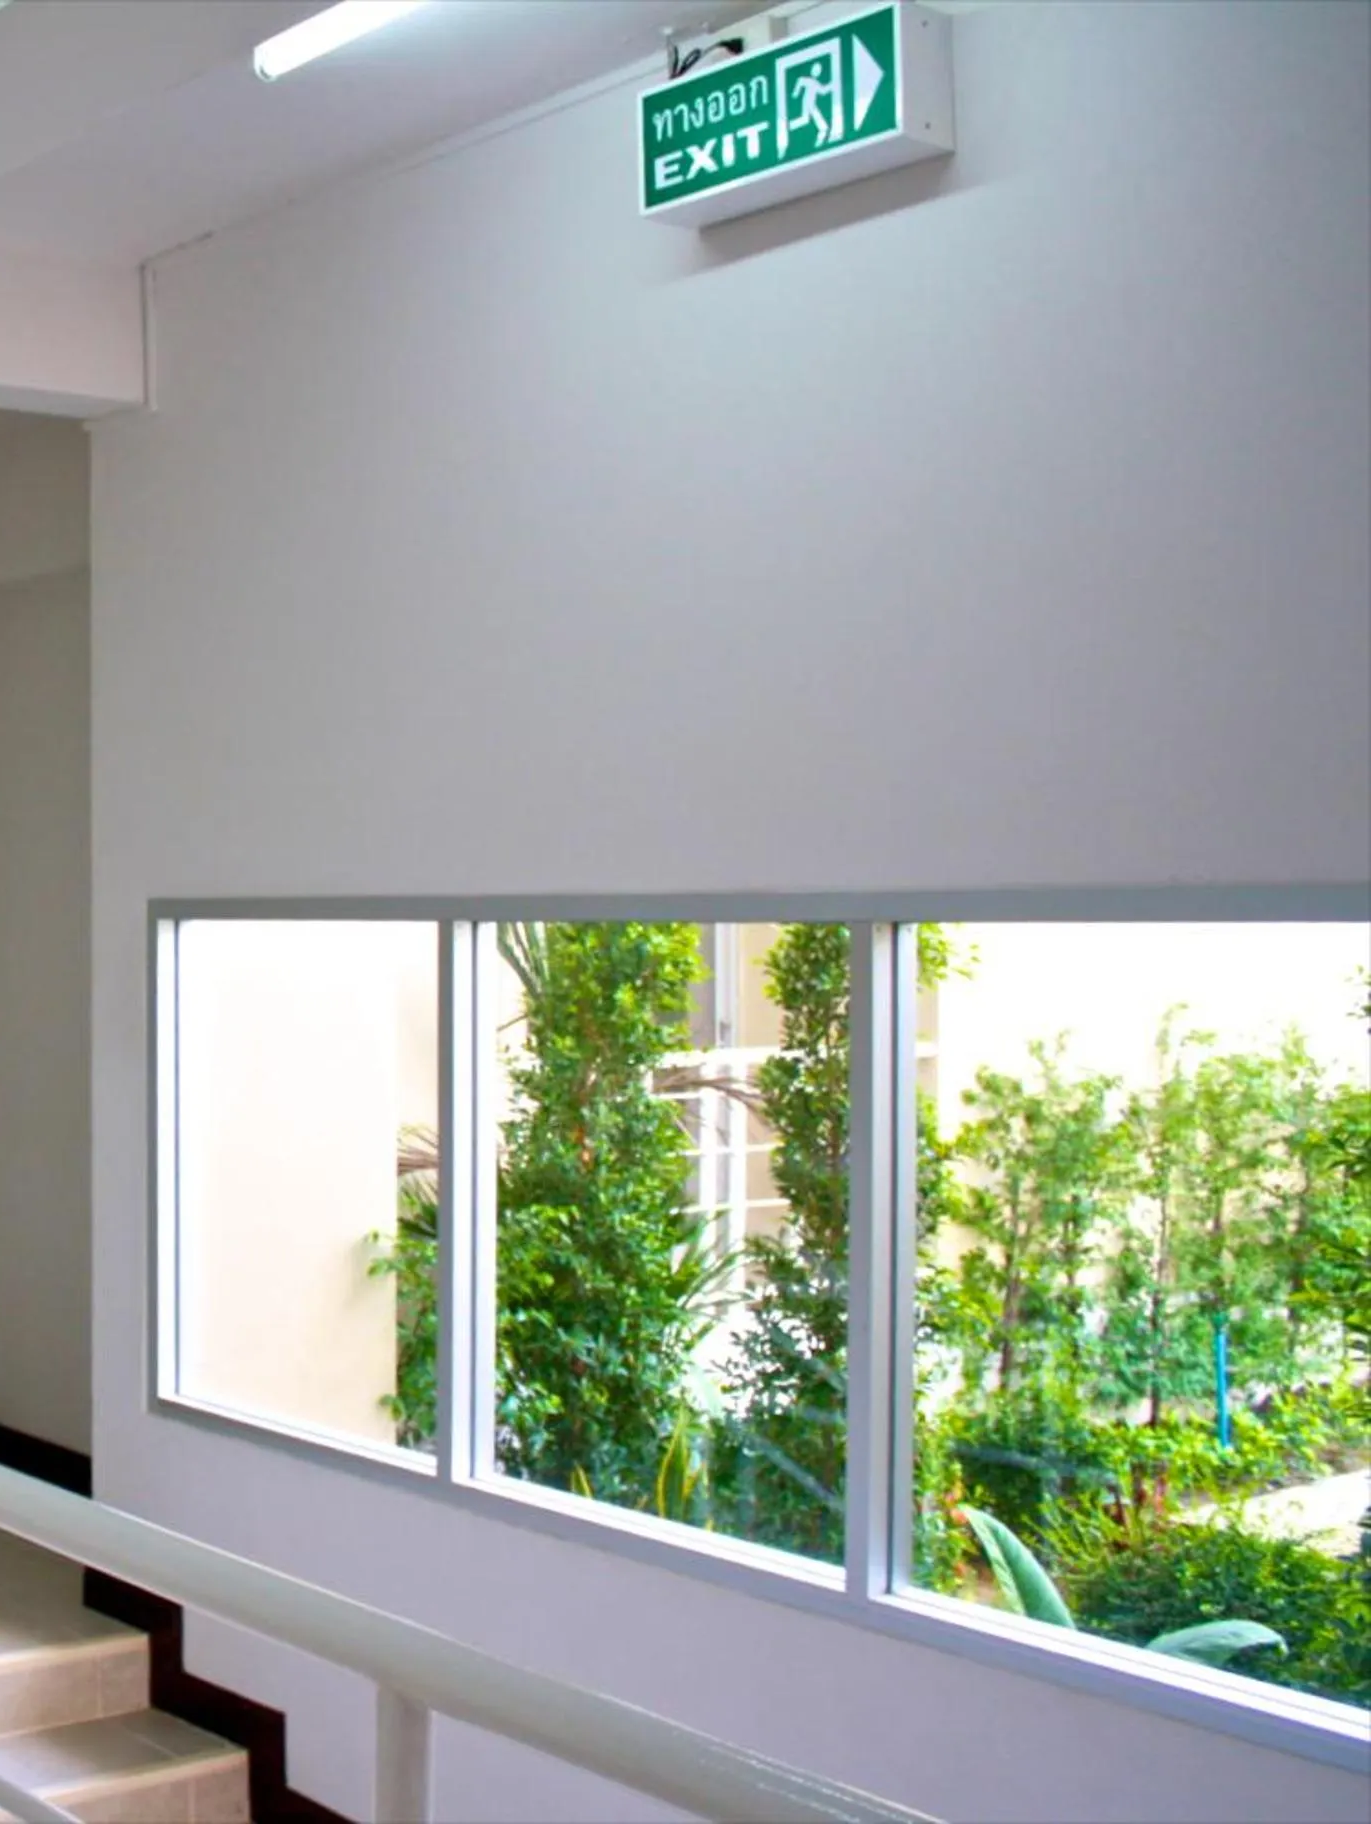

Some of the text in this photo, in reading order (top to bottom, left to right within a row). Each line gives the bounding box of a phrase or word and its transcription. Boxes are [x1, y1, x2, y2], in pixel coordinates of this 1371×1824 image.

[652, 75, 769, 142] ทางออก
[654, 122, 769, 189] EXIT
